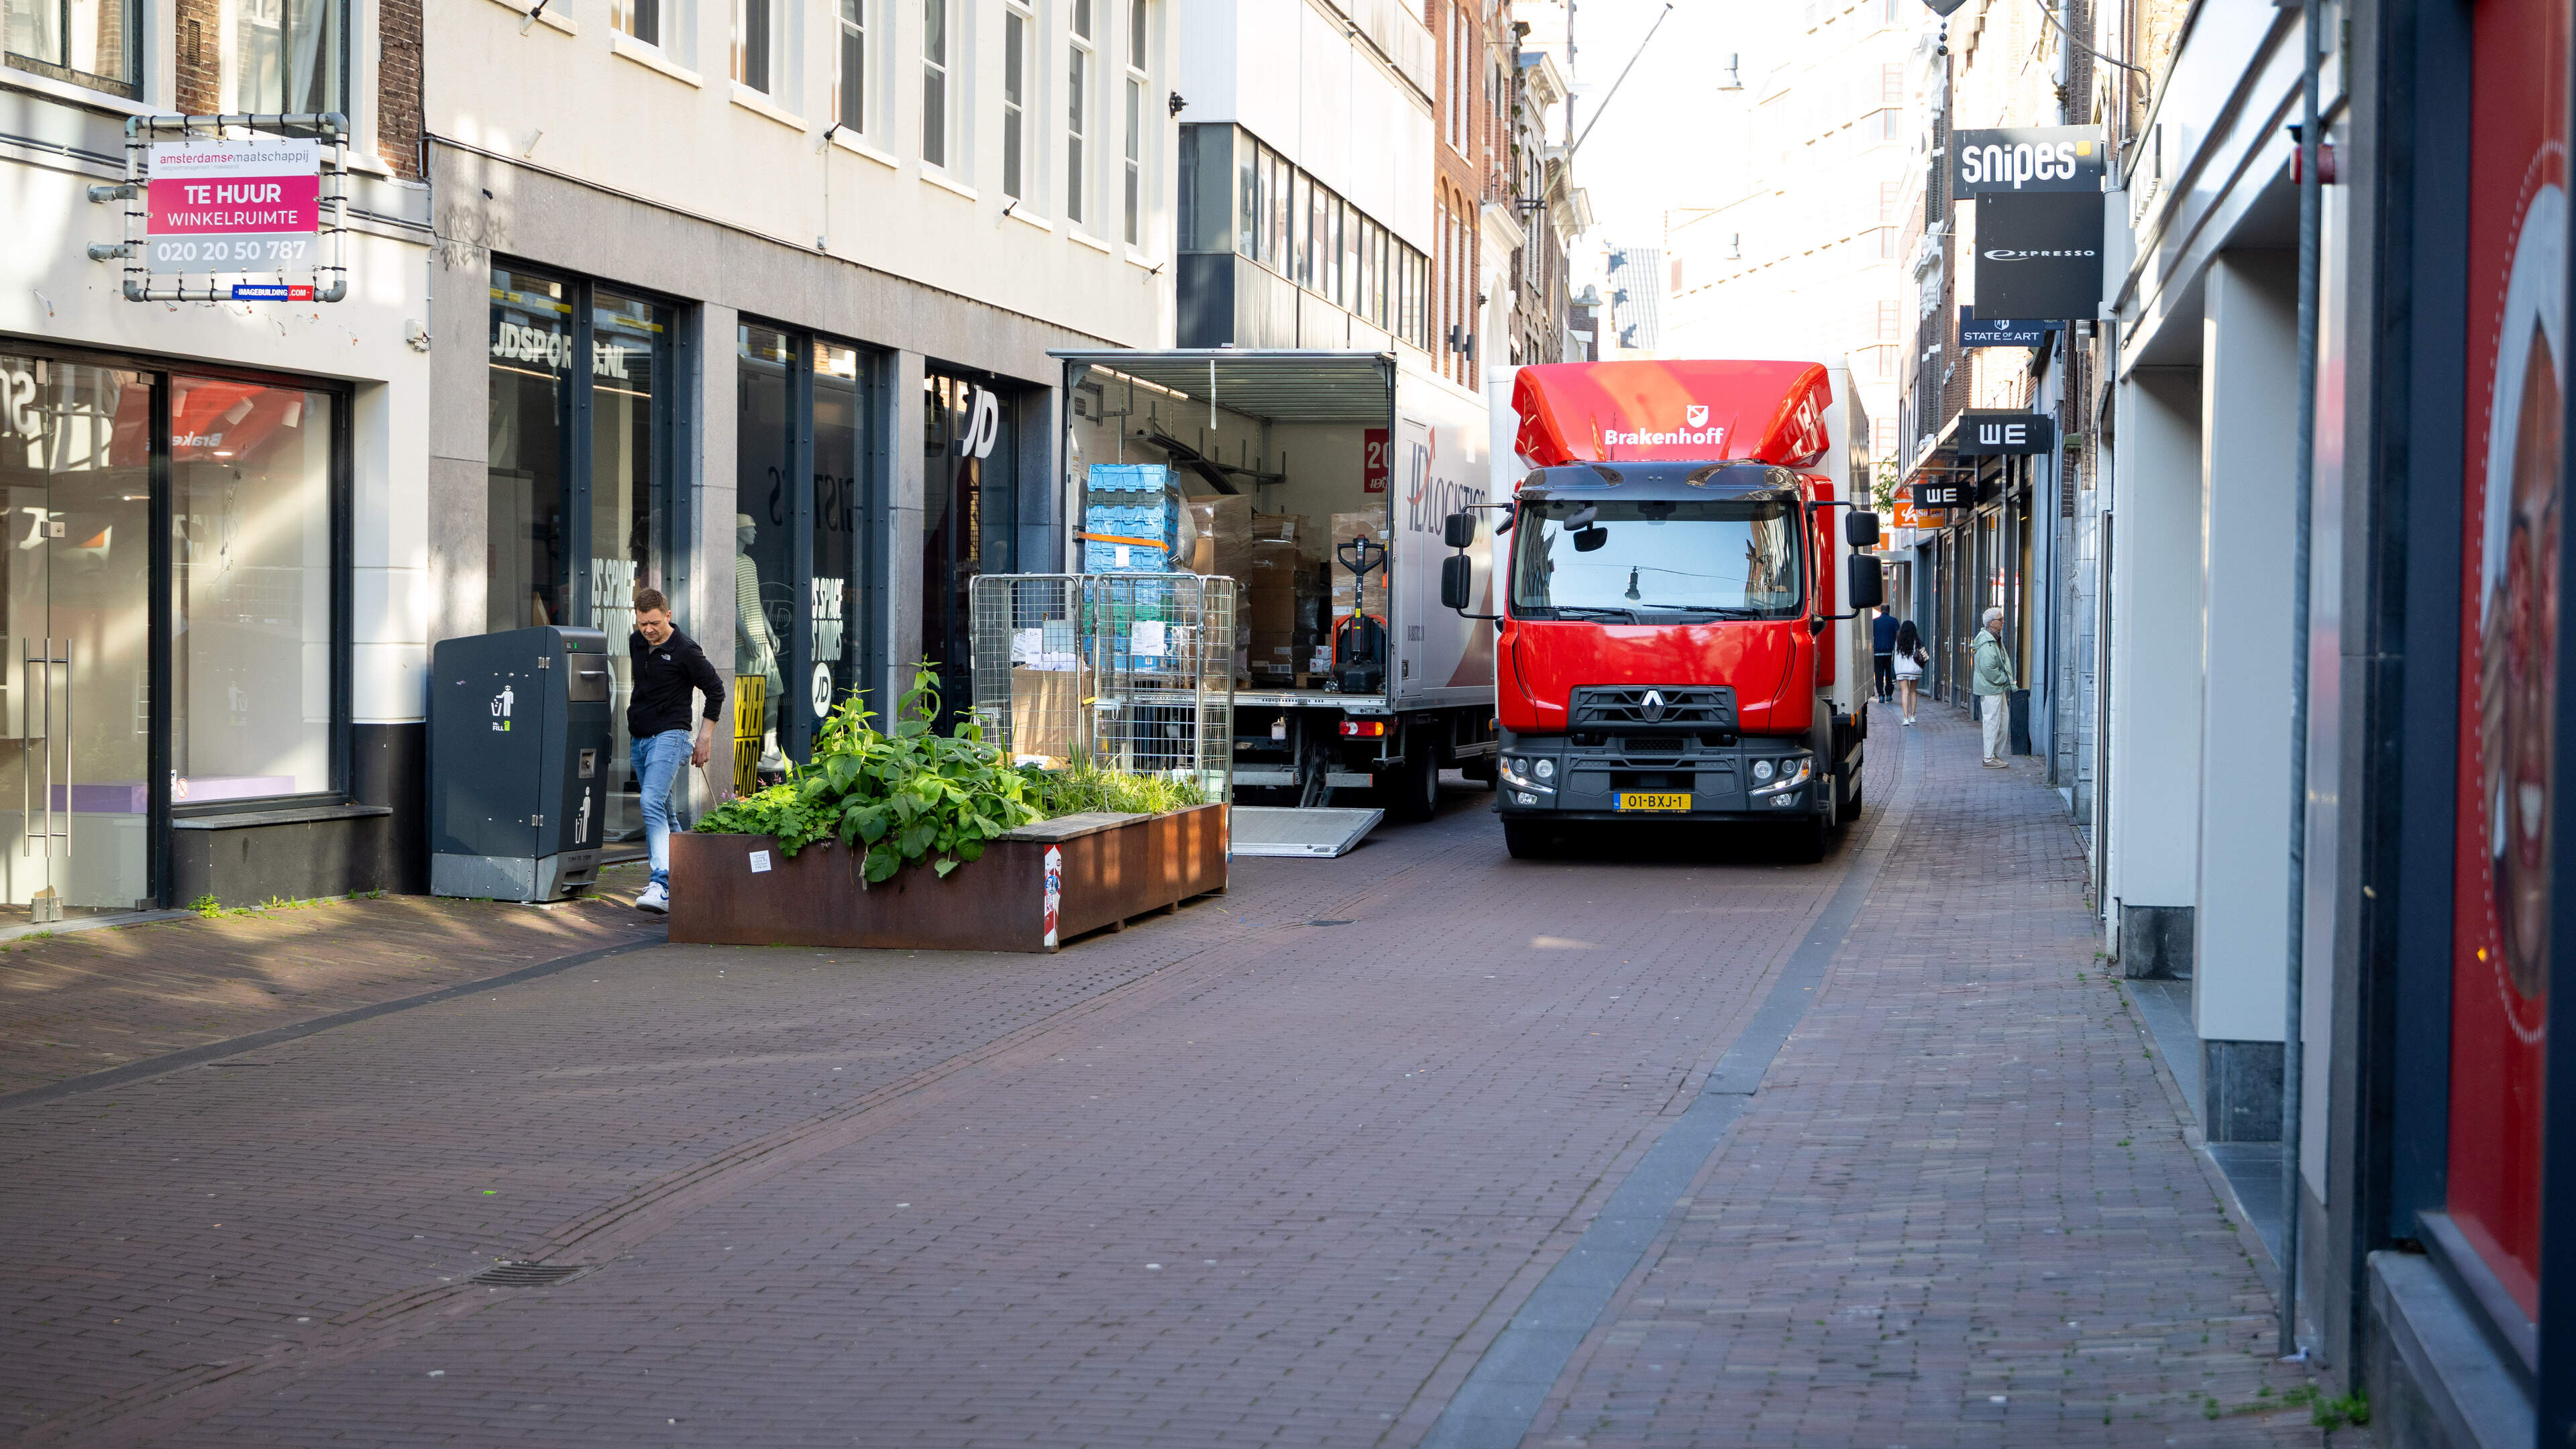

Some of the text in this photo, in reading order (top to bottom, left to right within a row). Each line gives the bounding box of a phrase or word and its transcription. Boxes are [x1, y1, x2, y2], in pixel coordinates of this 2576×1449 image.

[1962, 141, 2076, 190] snipes
[184, 184, 282, 205] TE HUUR
[168, 210, 299, 227] WINKELRUIMTE
[157, 241, 307, 262] 020 20 50 787
[1964, 332, 2039, 341] STATE OF ART
[492, 321, 629, 379] JDSPORS.NL
[962, 388, 999, 459] JD
[1979, 423, 2027, 445] WE
[1605, 427, 1725, 445] Brakenhoff
[1926, 488, 1957, 503] WE
[604, 557, 637, 607] SPACE
[818, 577, 844, 619] SPACE
[818, 620, 843, 661] YOURS
[814, 676, 829, 704] JD
[1628, 795, 1682, 808] 01-BXJ-1
